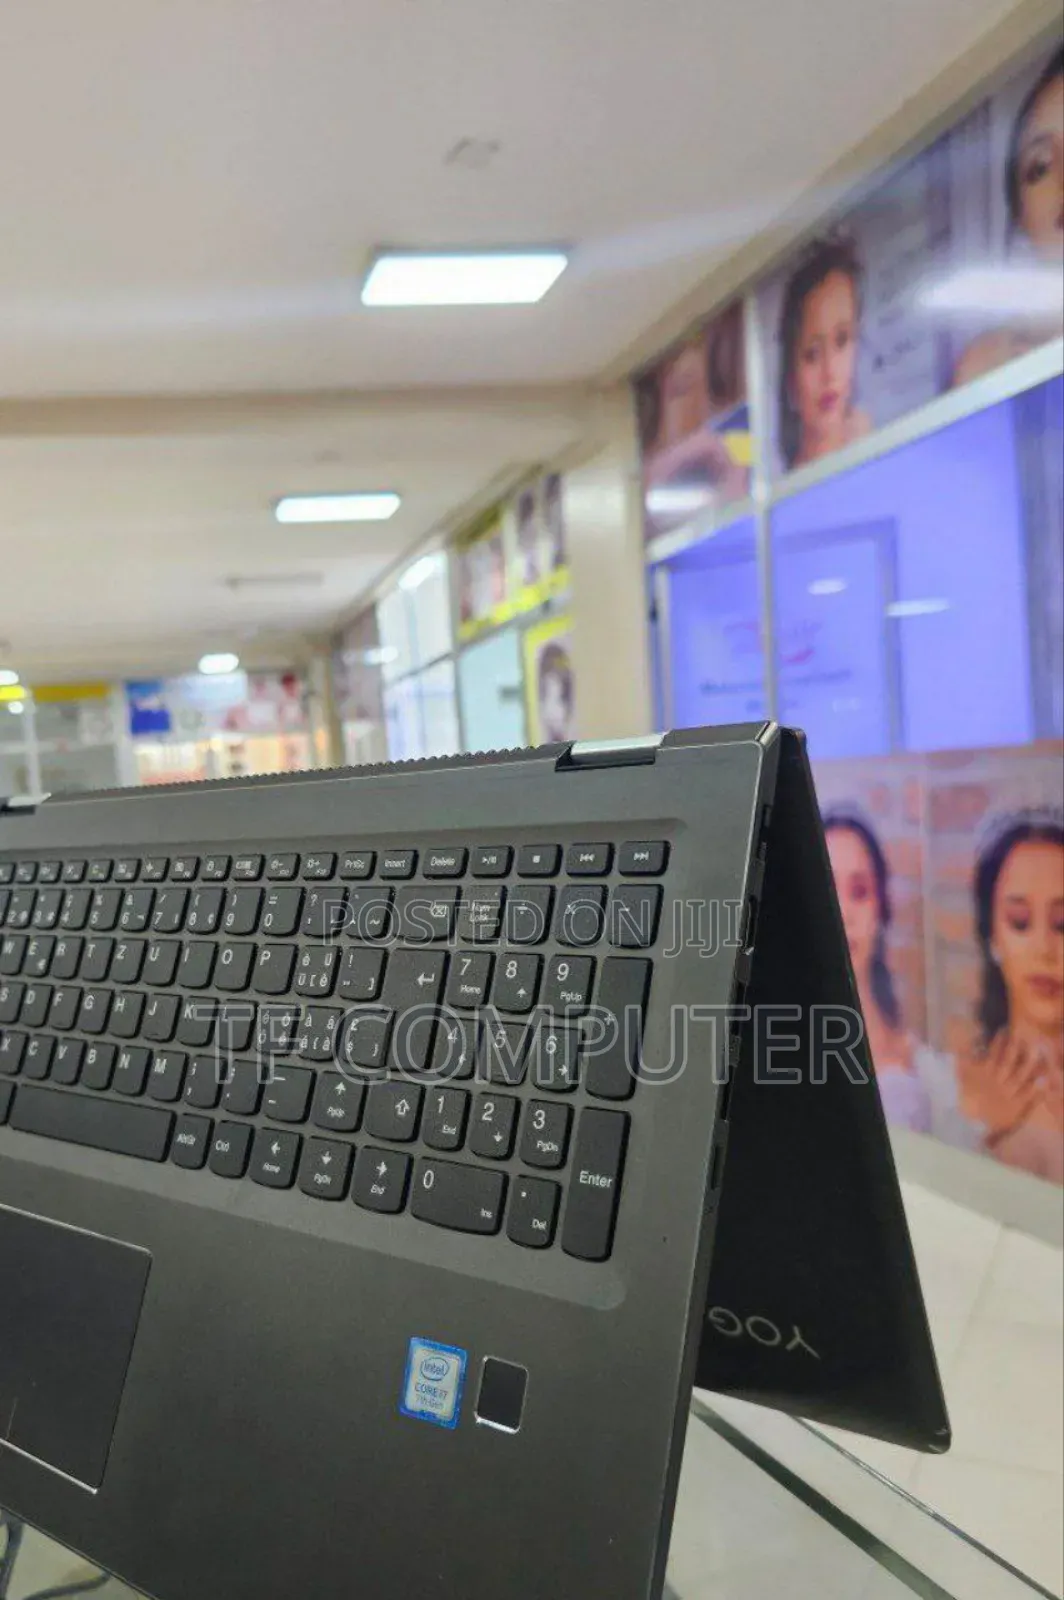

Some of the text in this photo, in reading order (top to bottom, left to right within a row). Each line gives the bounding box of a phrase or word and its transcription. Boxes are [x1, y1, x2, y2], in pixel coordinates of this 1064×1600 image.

[87, 944, 96, 958] T
[116, 946, 127, 959] Z
[149, 947, 159, 961] U
[260, 950, 271, 966] P
[460, 958, 472, 976] 7
[505, 960, 518, 979] 8
[556, 963, 570, 982] 9
[460, 984, 481, 995] Home
[560, 990, 583, 1002] PgUp
[25, 990, 36, 1004] D
[53, 992, 63, 1006] F
[84, 995, 95, 1009] G
[114, 998, 125, 1012] H
[448, 1027, 459, 1044] 4
[494, 1030, 507, 1049] 5
[28, 1041, 38, 1055] C
[546, 1035, 558, 1054] 6
[119, 1053, 131, 1069] N
[154, 1058, 168, 1074] M
[482, 1102, 495, 1121] 2
[532, 1109, 546, 1129] 3
[442, 1123, 457, 1135] End
[536, 1140, 559, 1152] PgDn
[579, 1170, 613, 1189] Enter
[532, 1218, 548, 1230] Del
